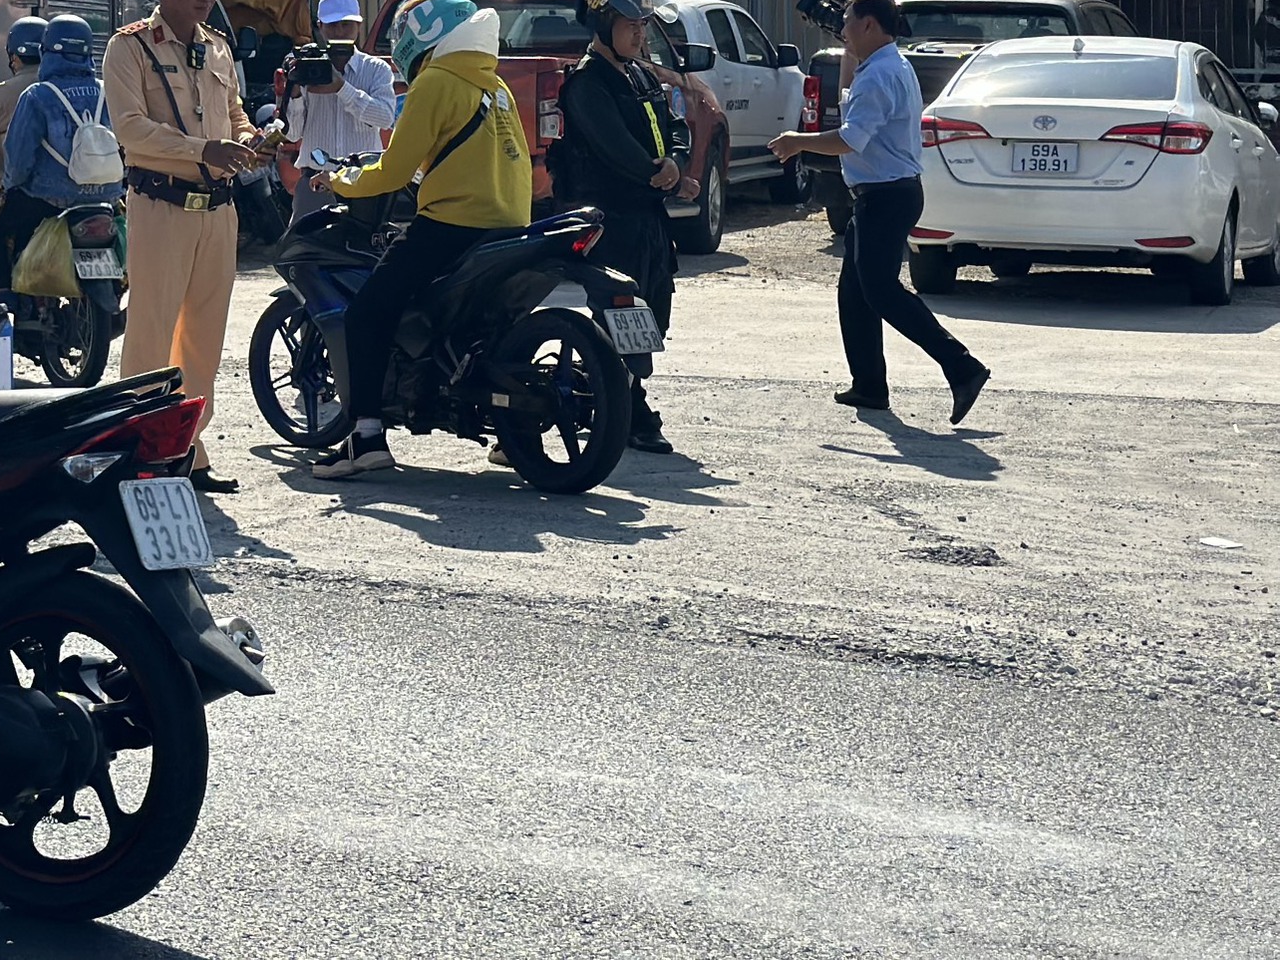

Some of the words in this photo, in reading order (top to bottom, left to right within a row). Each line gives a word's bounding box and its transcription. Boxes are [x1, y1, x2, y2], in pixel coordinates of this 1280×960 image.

[1031, 144, 1059, 158] 69A
[1019, 158, 1069, 172] 138.91
[613, 311, 649, 331] 69-H1
[617, 330, 660, 351] 414.58
[133, 485, 191, 522] 69-L1
[145, 524, 202, 562] 3349
